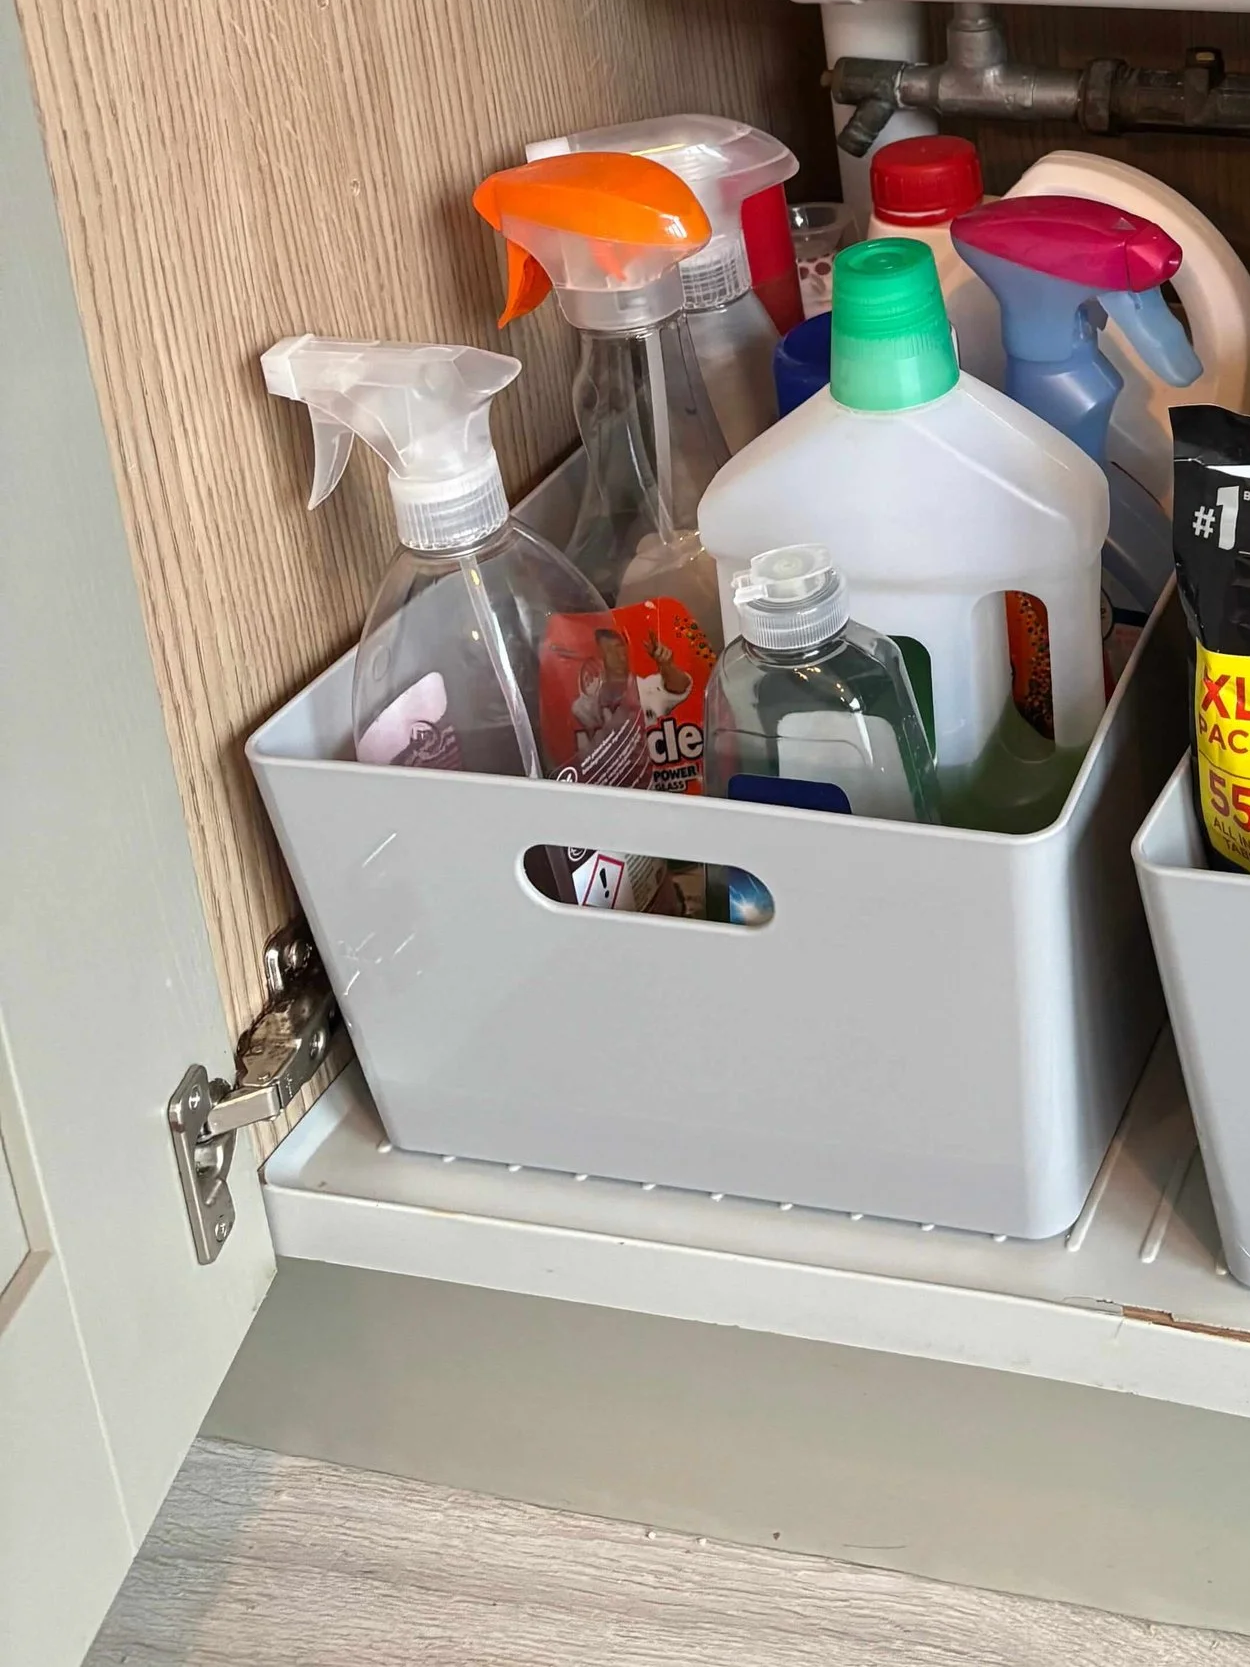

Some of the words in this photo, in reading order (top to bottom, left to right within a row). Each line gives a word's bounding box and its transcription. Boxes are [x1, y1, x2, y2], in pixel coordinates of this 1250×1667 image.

[1192, 485, 1240, 551] #1
[647, 719, 704, 764] cle
[653, 765, 697, 782] POWER
[1213, 817, 1237, 841] ALL
